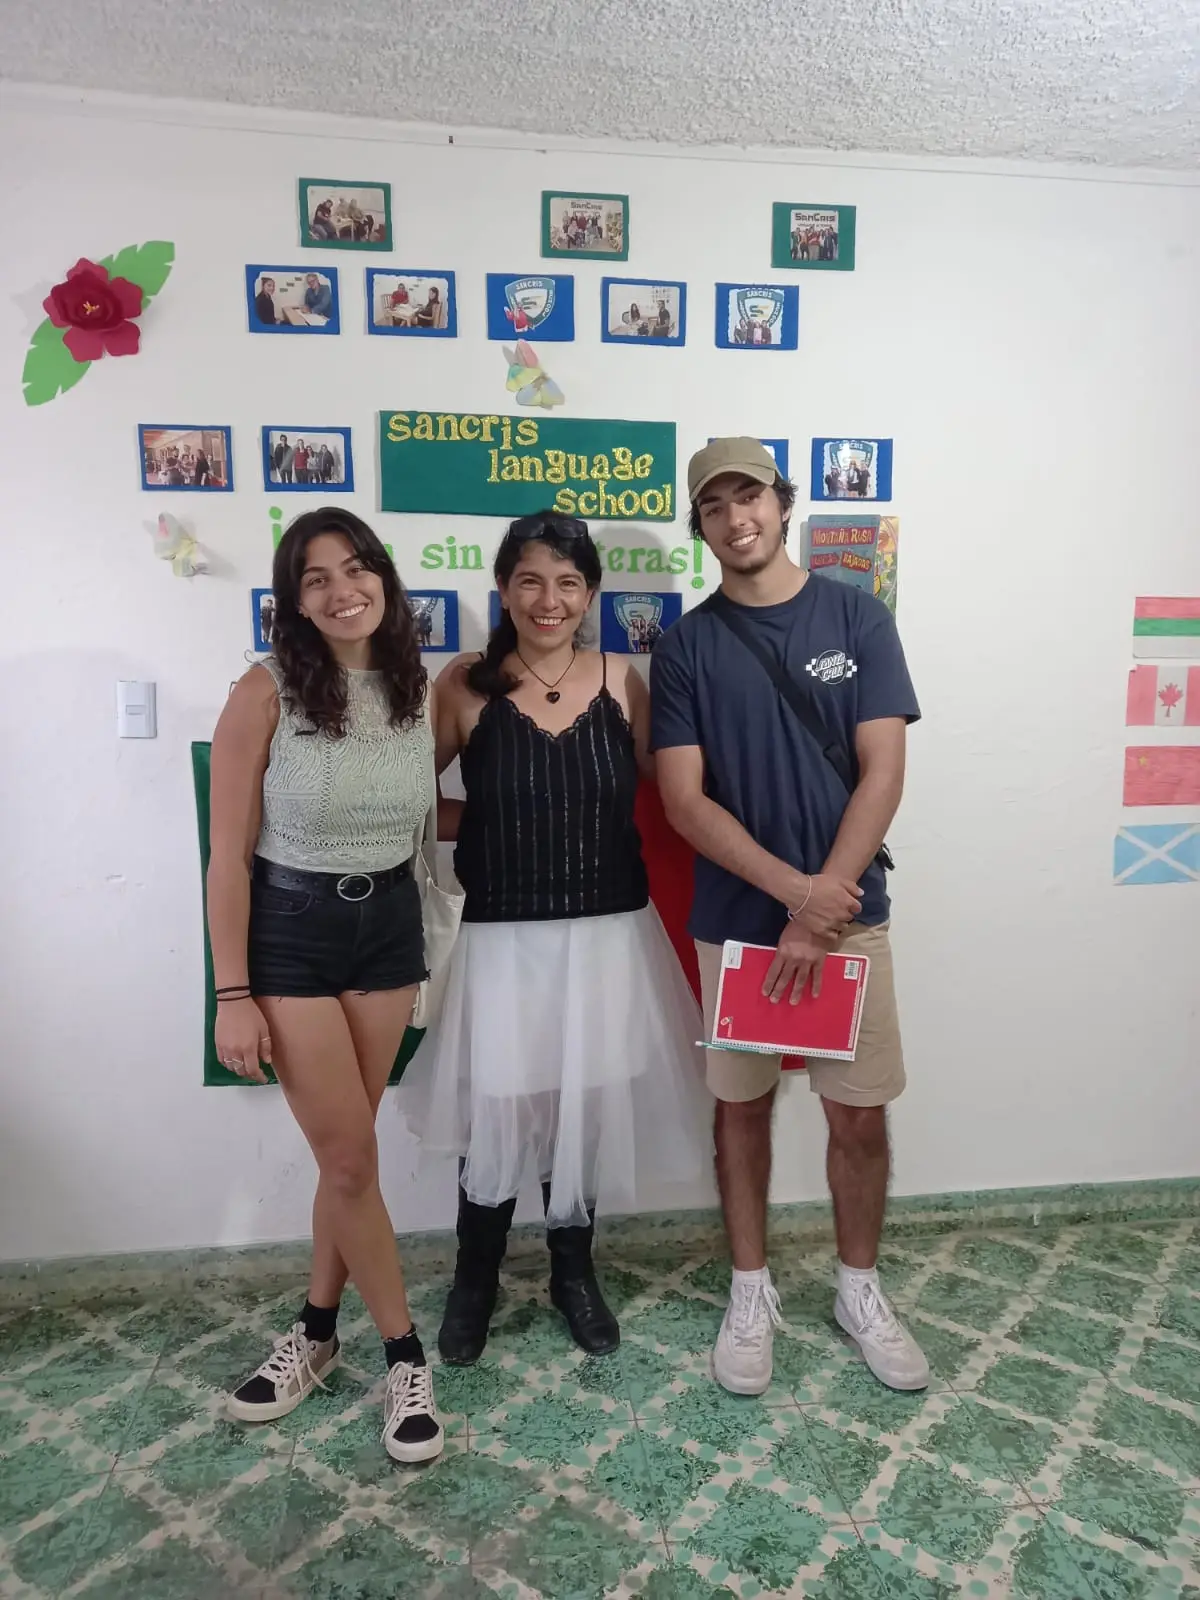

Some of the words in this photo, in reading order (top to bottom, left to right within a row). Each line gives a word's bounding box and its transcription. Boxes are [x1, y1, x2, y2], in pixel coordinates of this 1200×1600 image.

[386, 412, 539, 450] sancris
[486, 446, 654, 484] language
[552, 480, 673, 517] school
[420, 535, 485, 570] sin
